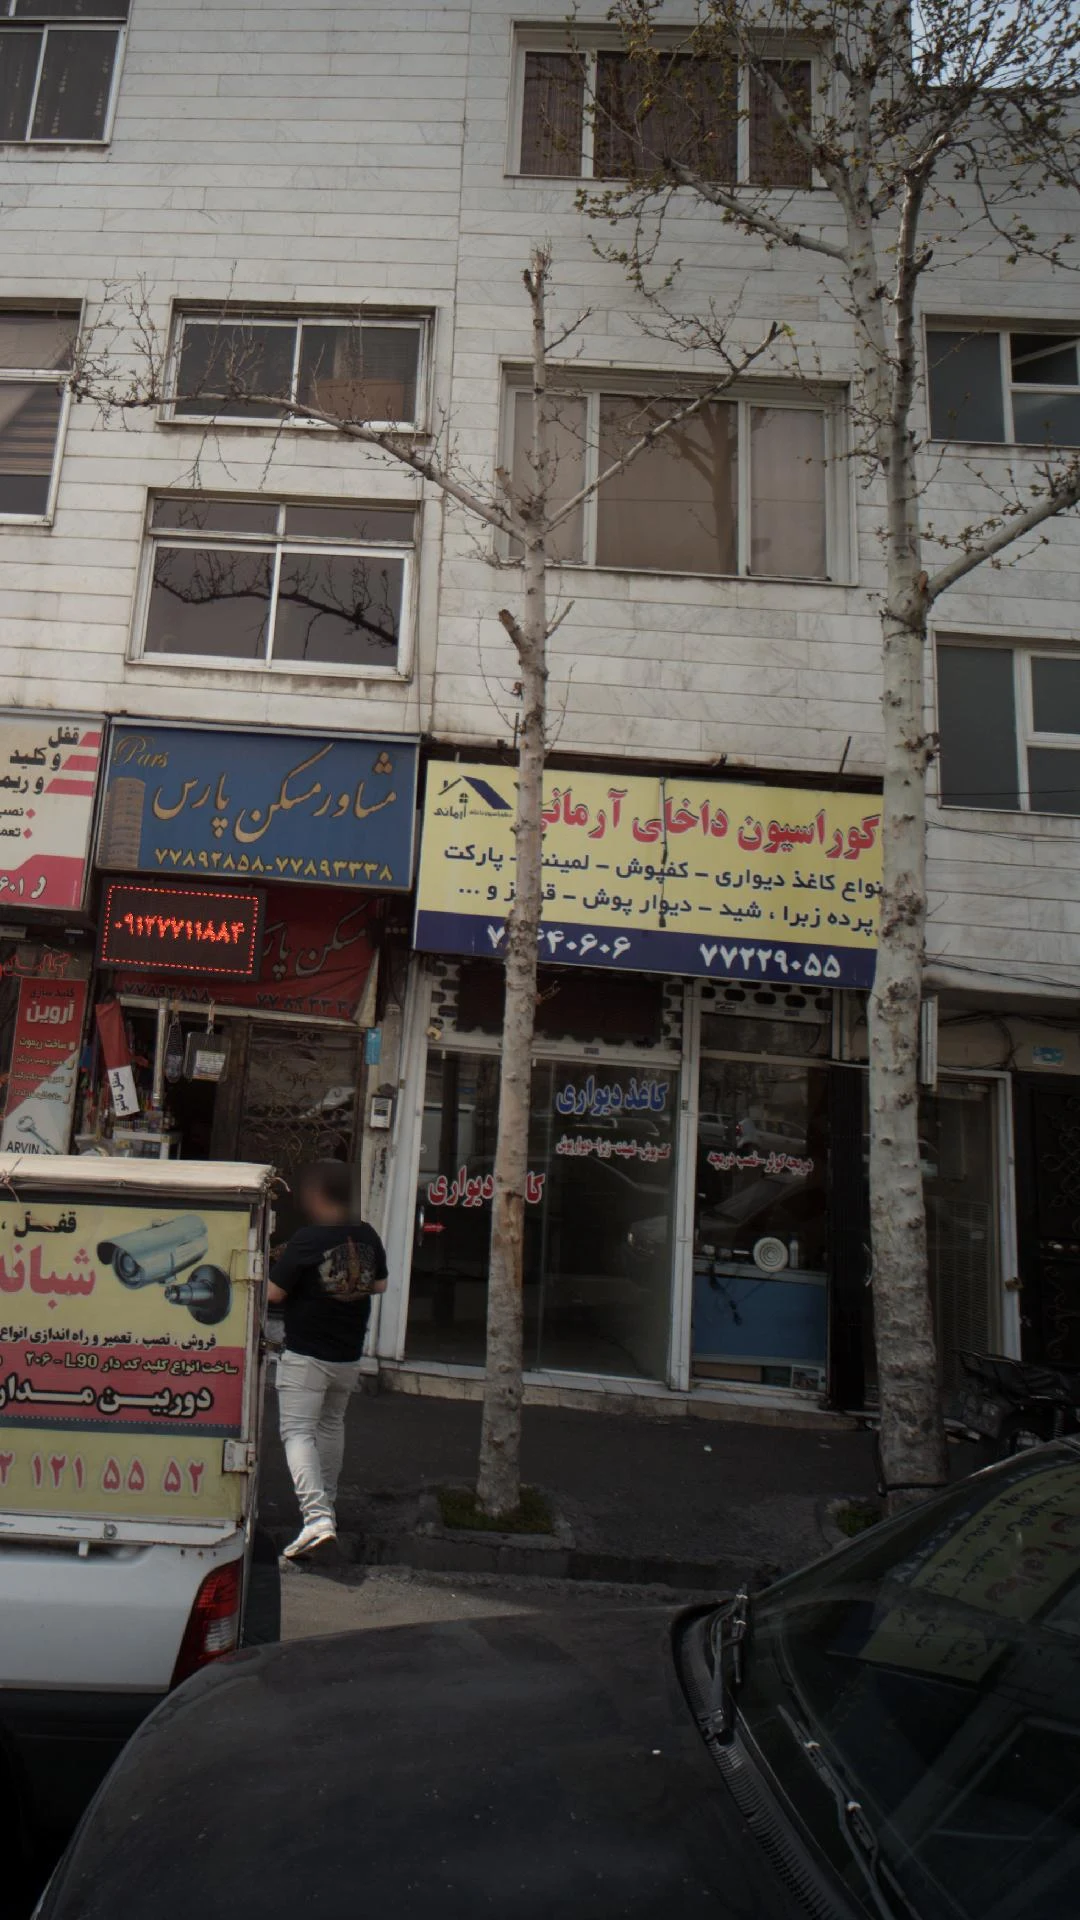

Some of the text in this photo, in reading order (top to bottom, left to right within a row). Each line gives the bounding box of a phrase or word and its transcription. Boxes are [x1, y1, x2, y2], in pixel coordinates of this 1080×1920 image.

[48, 726, 80, 748] قفل
[9, 747, 61, 771] و کلید
[112, 735, 169, 768] Pars
[0, 775, 45, 794] و ریم
[152, 742, 397, 844] مشاور مسکن پارس
[0, 828, 21, 837] تعم
[541, 786, 882, 861] کوراسیون داخلی آرمان
[444, 845, 503, 871] پارکت
[541, 851, 589, 873] لمین
[616, 858, 689, 884] کفپوش
[715, 869, 785, 890] دیواری
[792, 870, 836, 892] کاغذ
[487, 884, 497, 900] و
[841, 879, 885, 902] نواع
[639, 894, 692, 916] دیوار
[719, 902, 761, 922] شید
[783, 905, 821, 928] زبرا
[827, 911, 874, 936] پرده
[487, 924, 631, 960] ۷۴۰۶۰۶
[699, 943, 841, 979] ۷۷۲۲۹۰۵۵
[26, 1000, 76, 1025] آروین
[556, 1075, 670, 1116] کاغذ دیواری
[6, 1141, 40, 1155] ARVIN
[428, 1165, 494, 1207] دیواری
[14, 1211, 76, 1238] قفل
[0, 1244, 96, 1310] شبان
[0, 1325, 27, 1342] انواع
[30, 1327, 70, 1344] اندازی
[72, 1328, 89, 1346] راه
[91, 1334, 98, 1346] و
[101, 1331, 132, 1347] تعمیر
[142, 1333, 170, 1348] نصب
[181, 1333, 216, 1350] فروش
[25, 1351, 52, 1366] ۲۰۶
[65, 1352, 98, 1369] L90
[101, 1356, 121, 1372] دار
[123, 1357, 141, 1370] کد
[143, 1359, 169, 1374] کلید
[169, 1359, 200, 1375] انواع
[201, 1360, 239, 1374] ساخت
[97, 1386, 214, 1418] دوربین
[32, 1454, 84, 1489] ۱۲۱
[102, 1457, 146, 1491] ۵۵
[163, 1460, 205, 1494] ۵۲
